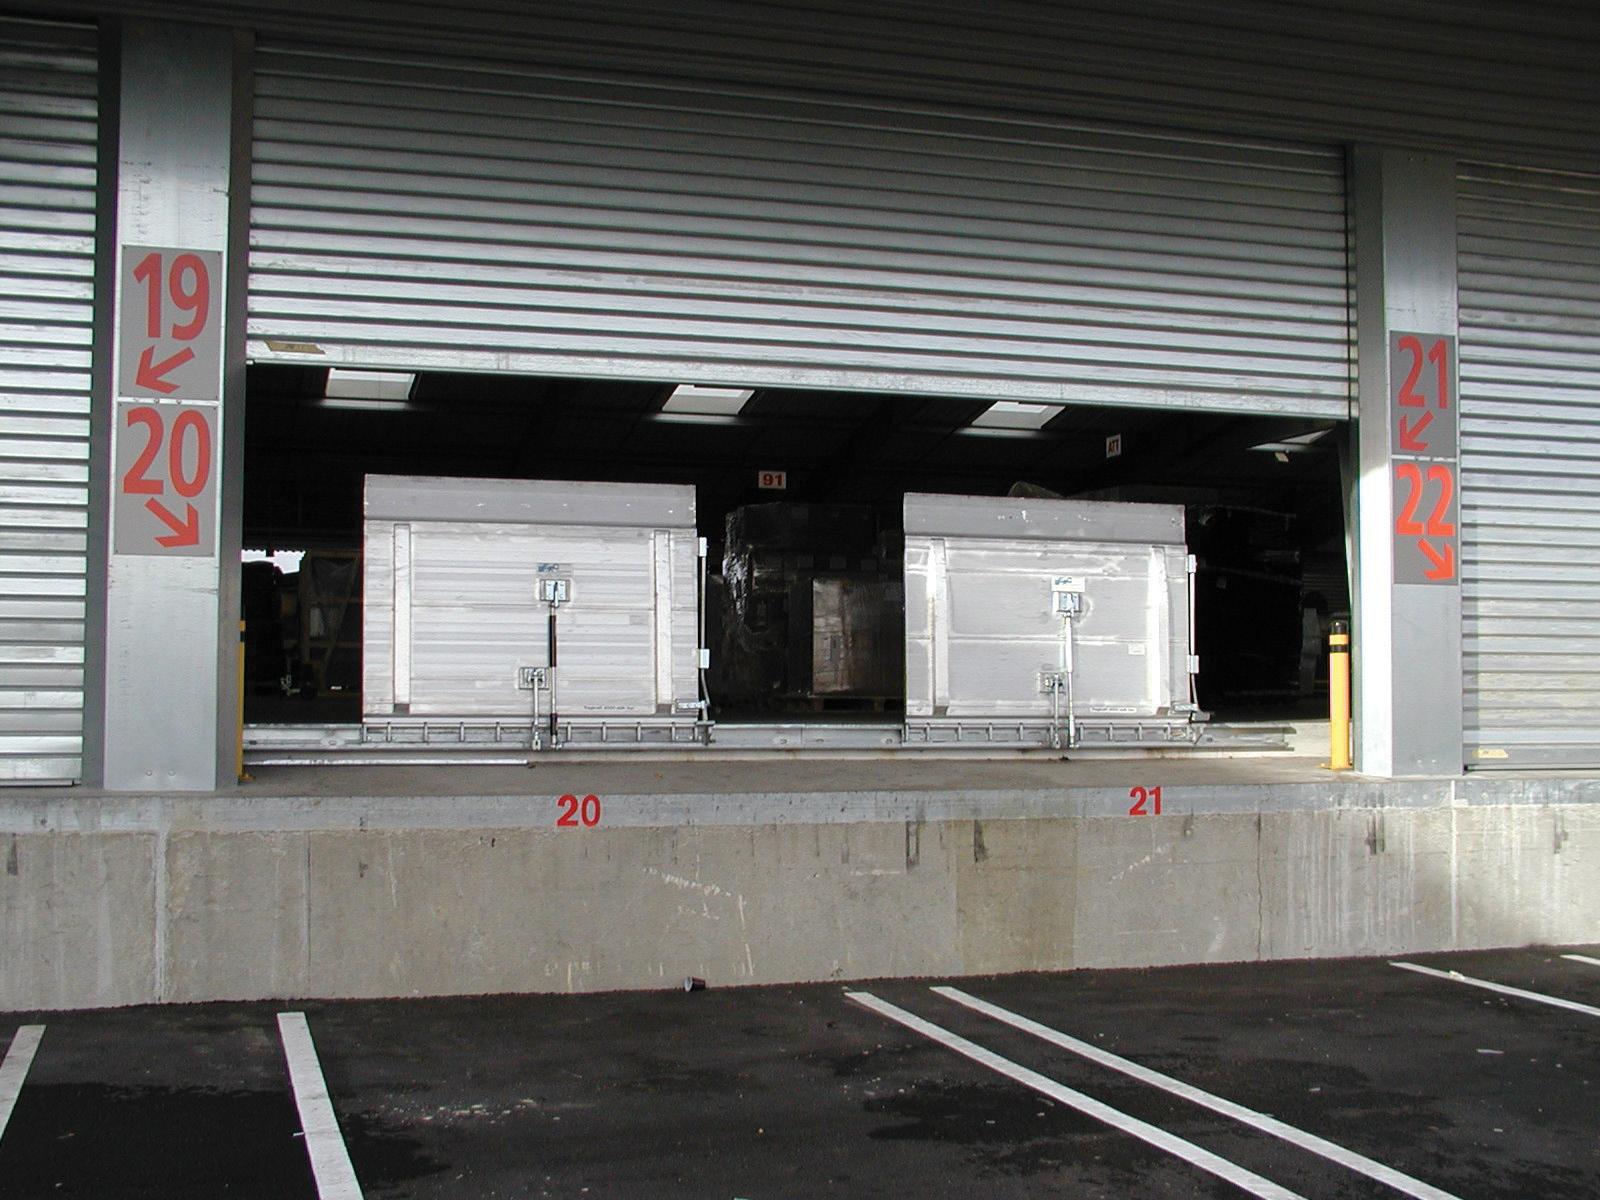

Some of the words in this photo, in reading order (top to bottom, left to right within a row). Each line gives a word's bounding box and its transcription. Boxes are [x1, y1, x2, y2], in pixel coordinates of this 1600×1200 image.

[133, 252, 210, 341] 19
[1397, 335, 1448, 409] 21
[123, 406, 211, 498] 20
[763, 473, 783, 487] 91
[1396, 463, 1456, 536] 22
[557, 793, 601, 827] 20
[1129, 785, 1161, 816] 21
